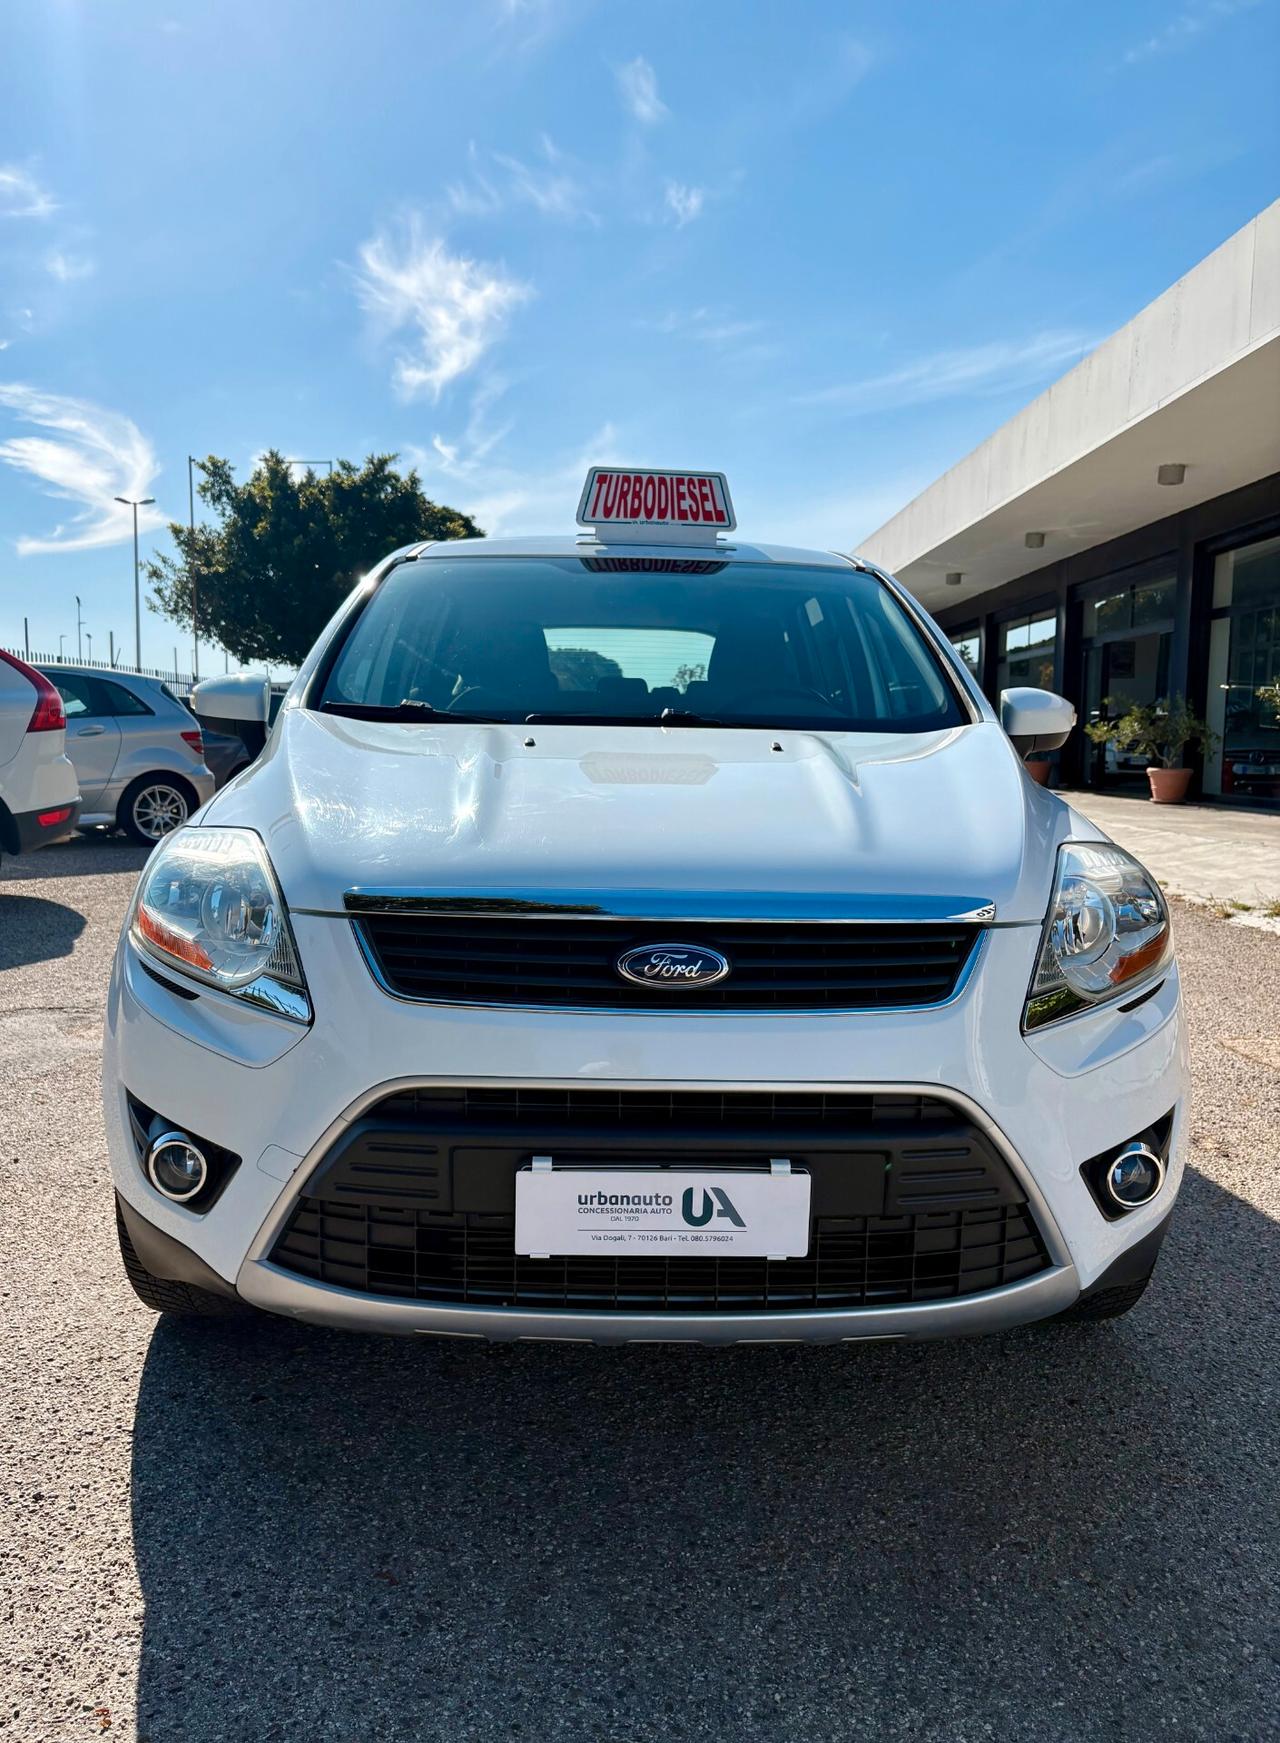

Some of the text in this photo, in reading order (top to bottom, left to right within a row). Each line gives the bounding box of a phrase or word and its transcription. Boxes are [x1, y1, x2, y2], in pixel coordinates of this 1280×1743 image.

[591, 474, 726, 522] TURBODIESEL
[644, 952, 703, 977] Ford
[578, 1191, 672, 1206] urbanauto
[682, 1186, 747, 1227] UA
